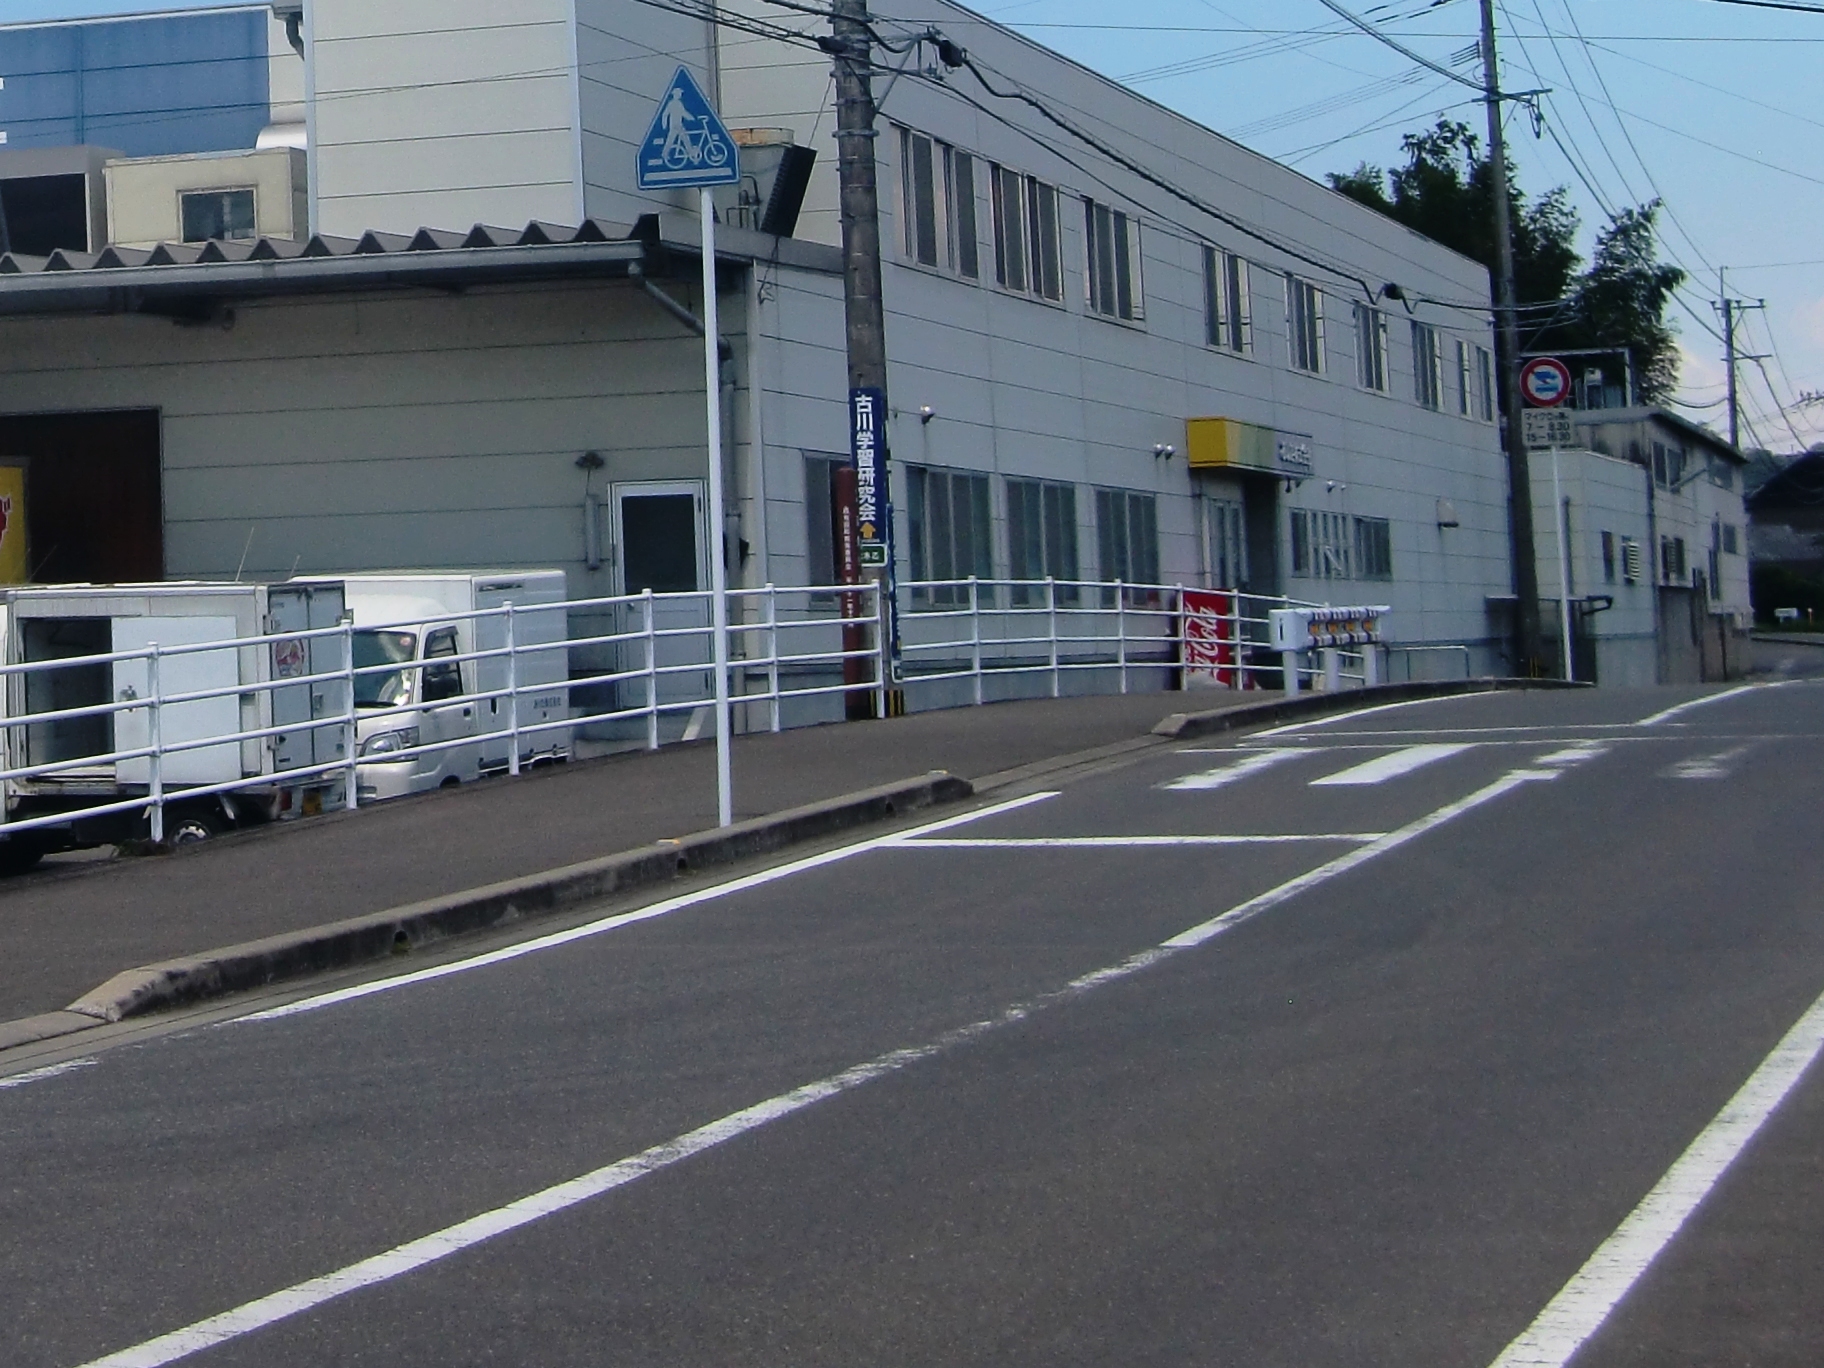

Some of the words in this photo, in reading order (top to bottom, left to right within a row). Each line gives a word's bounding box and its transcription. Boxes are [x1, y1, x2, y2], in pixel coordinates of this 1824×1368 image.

[854, 393, 876, 522] 古川学習研究会
